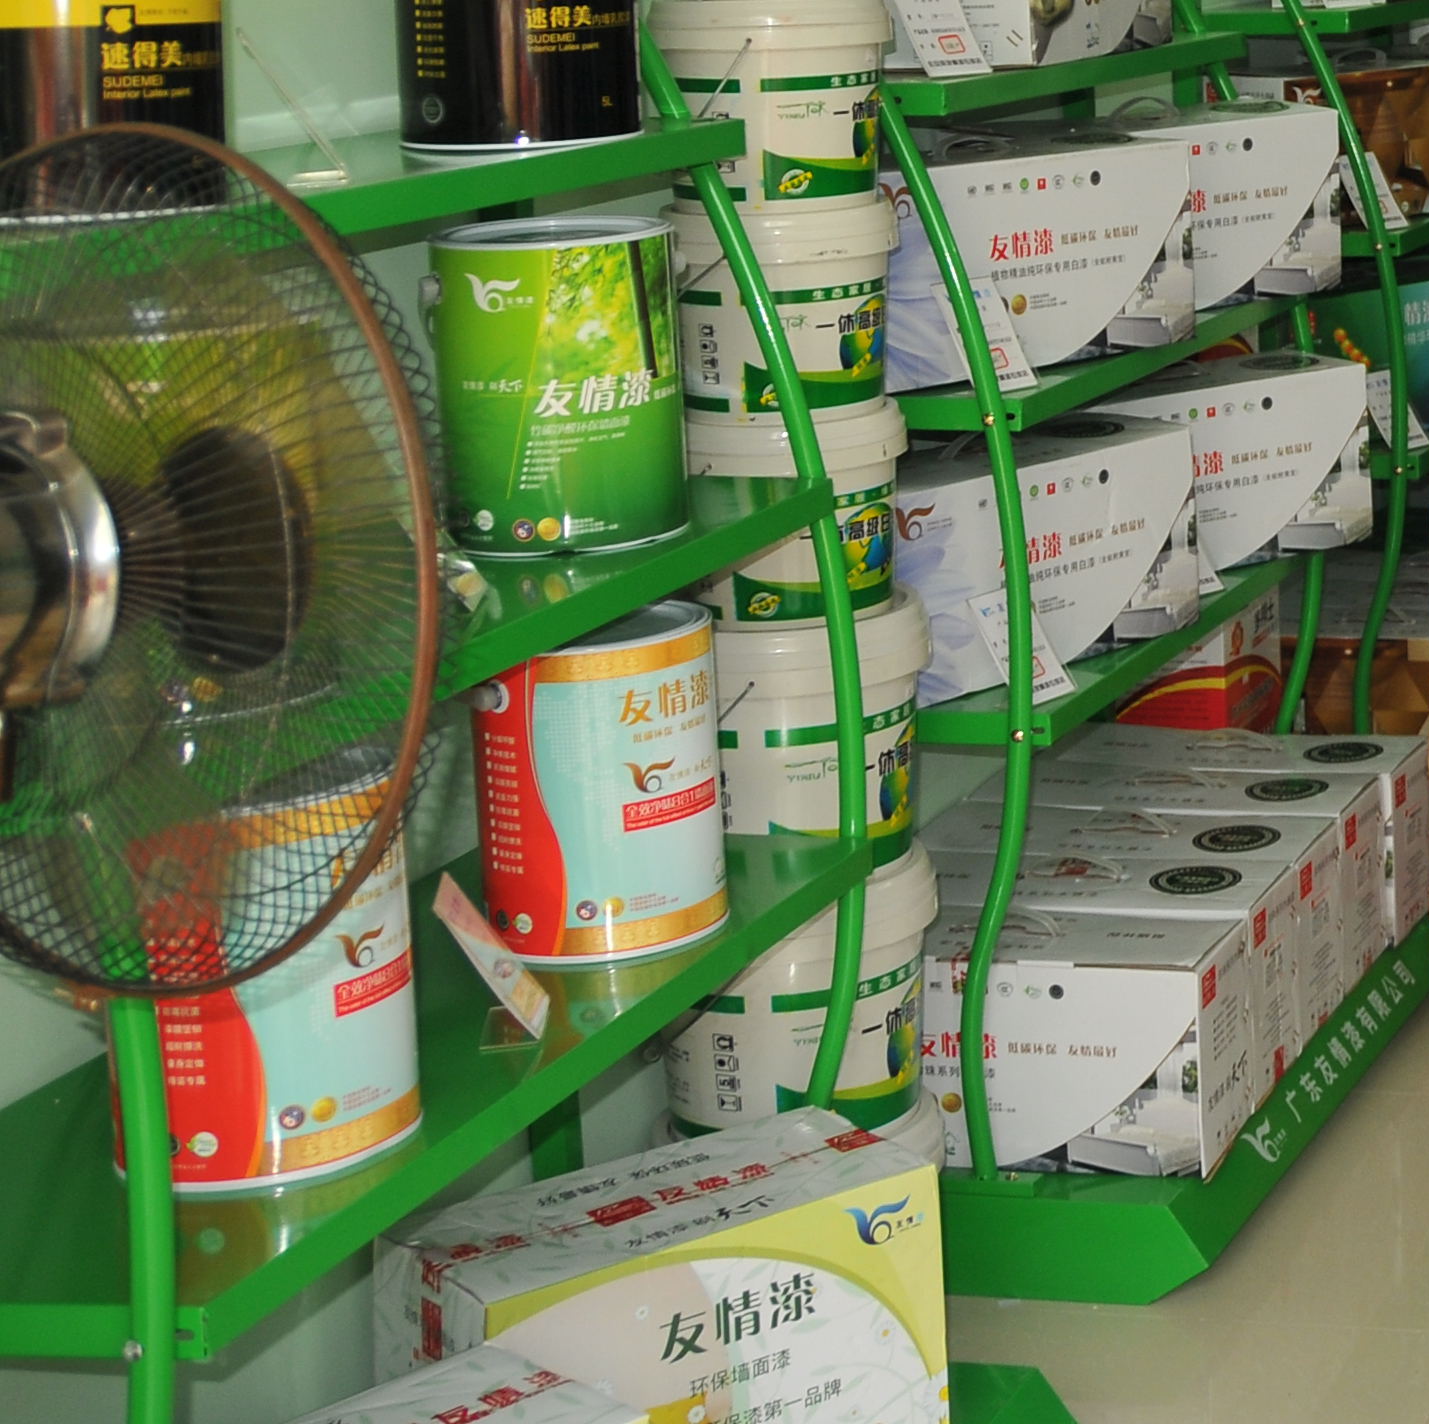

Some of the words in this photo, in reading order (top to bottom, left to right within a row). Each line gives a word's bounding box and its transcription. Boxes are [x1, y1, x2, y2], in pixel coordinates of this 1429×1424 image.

[525, 5, 591, 29] 速得美
[101, 40, 183, 70] 速得美
[527, 32, 576, 44] SUDEMEI
[103, 74, 164, 88] SUDEMEI
[989, 227, 1054, 262] 友情漆
[533, 368, 654, 418] 友情漆
[618, 669, 711, 726] 友情漆
[1007, 1040, 1057, 1055] 低碳环保
[1067, 1044, 1118, 1059] 友情最好
[1285, 959, 1417, 1124] 广东友情漆有限公司
[660, 1271, 815, 1364] 友情漆
[689, 1347, 792, 1400] 环保墙面漆
[708, 1378, 842, 1424] 保漆第一品牌
